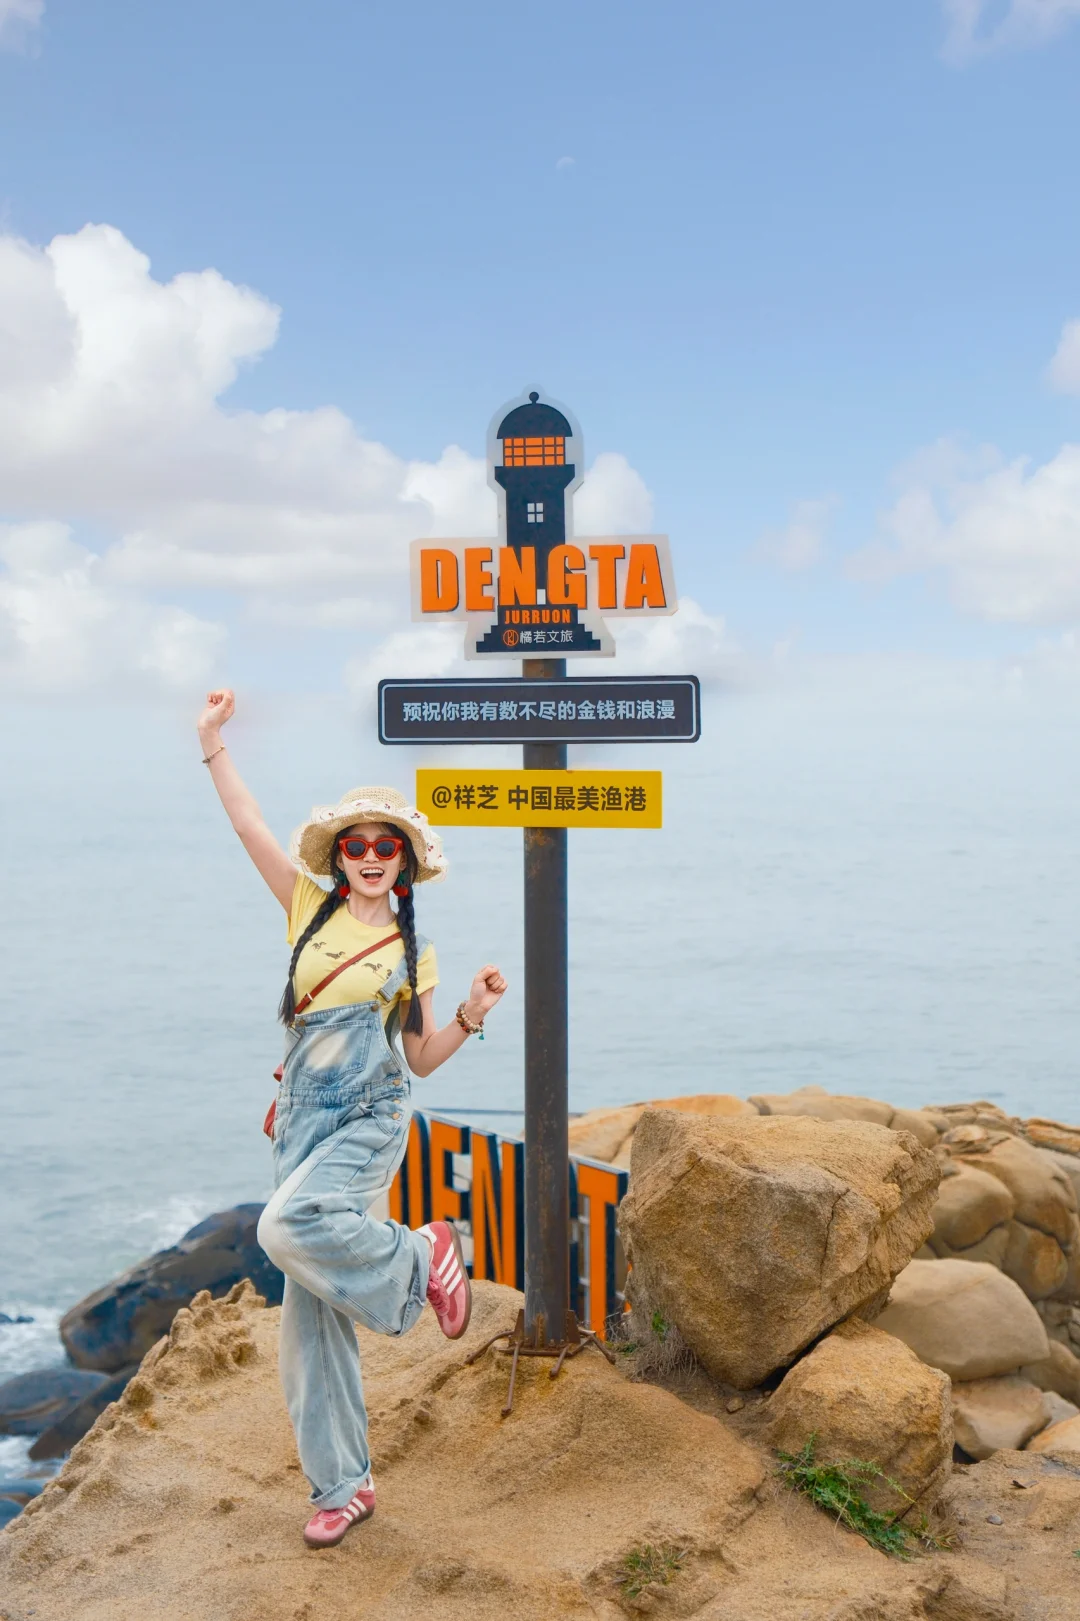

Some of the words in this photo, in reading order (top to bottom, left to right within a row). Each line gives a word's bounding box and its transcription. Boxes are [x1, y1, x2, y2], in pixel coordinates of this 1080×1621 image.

[420, 544, 667, 612] DENGTA
[505, 609, 571, 624] JURRUON
[519, 630, 573, 644] 橘若文旅
[402, 700, 676, 722] 预祝你我有数不尽的金钱和浪漫
[431, 785, 499, 809] @祥芝
[508, 785, 647, 811] 中国最美渔港
